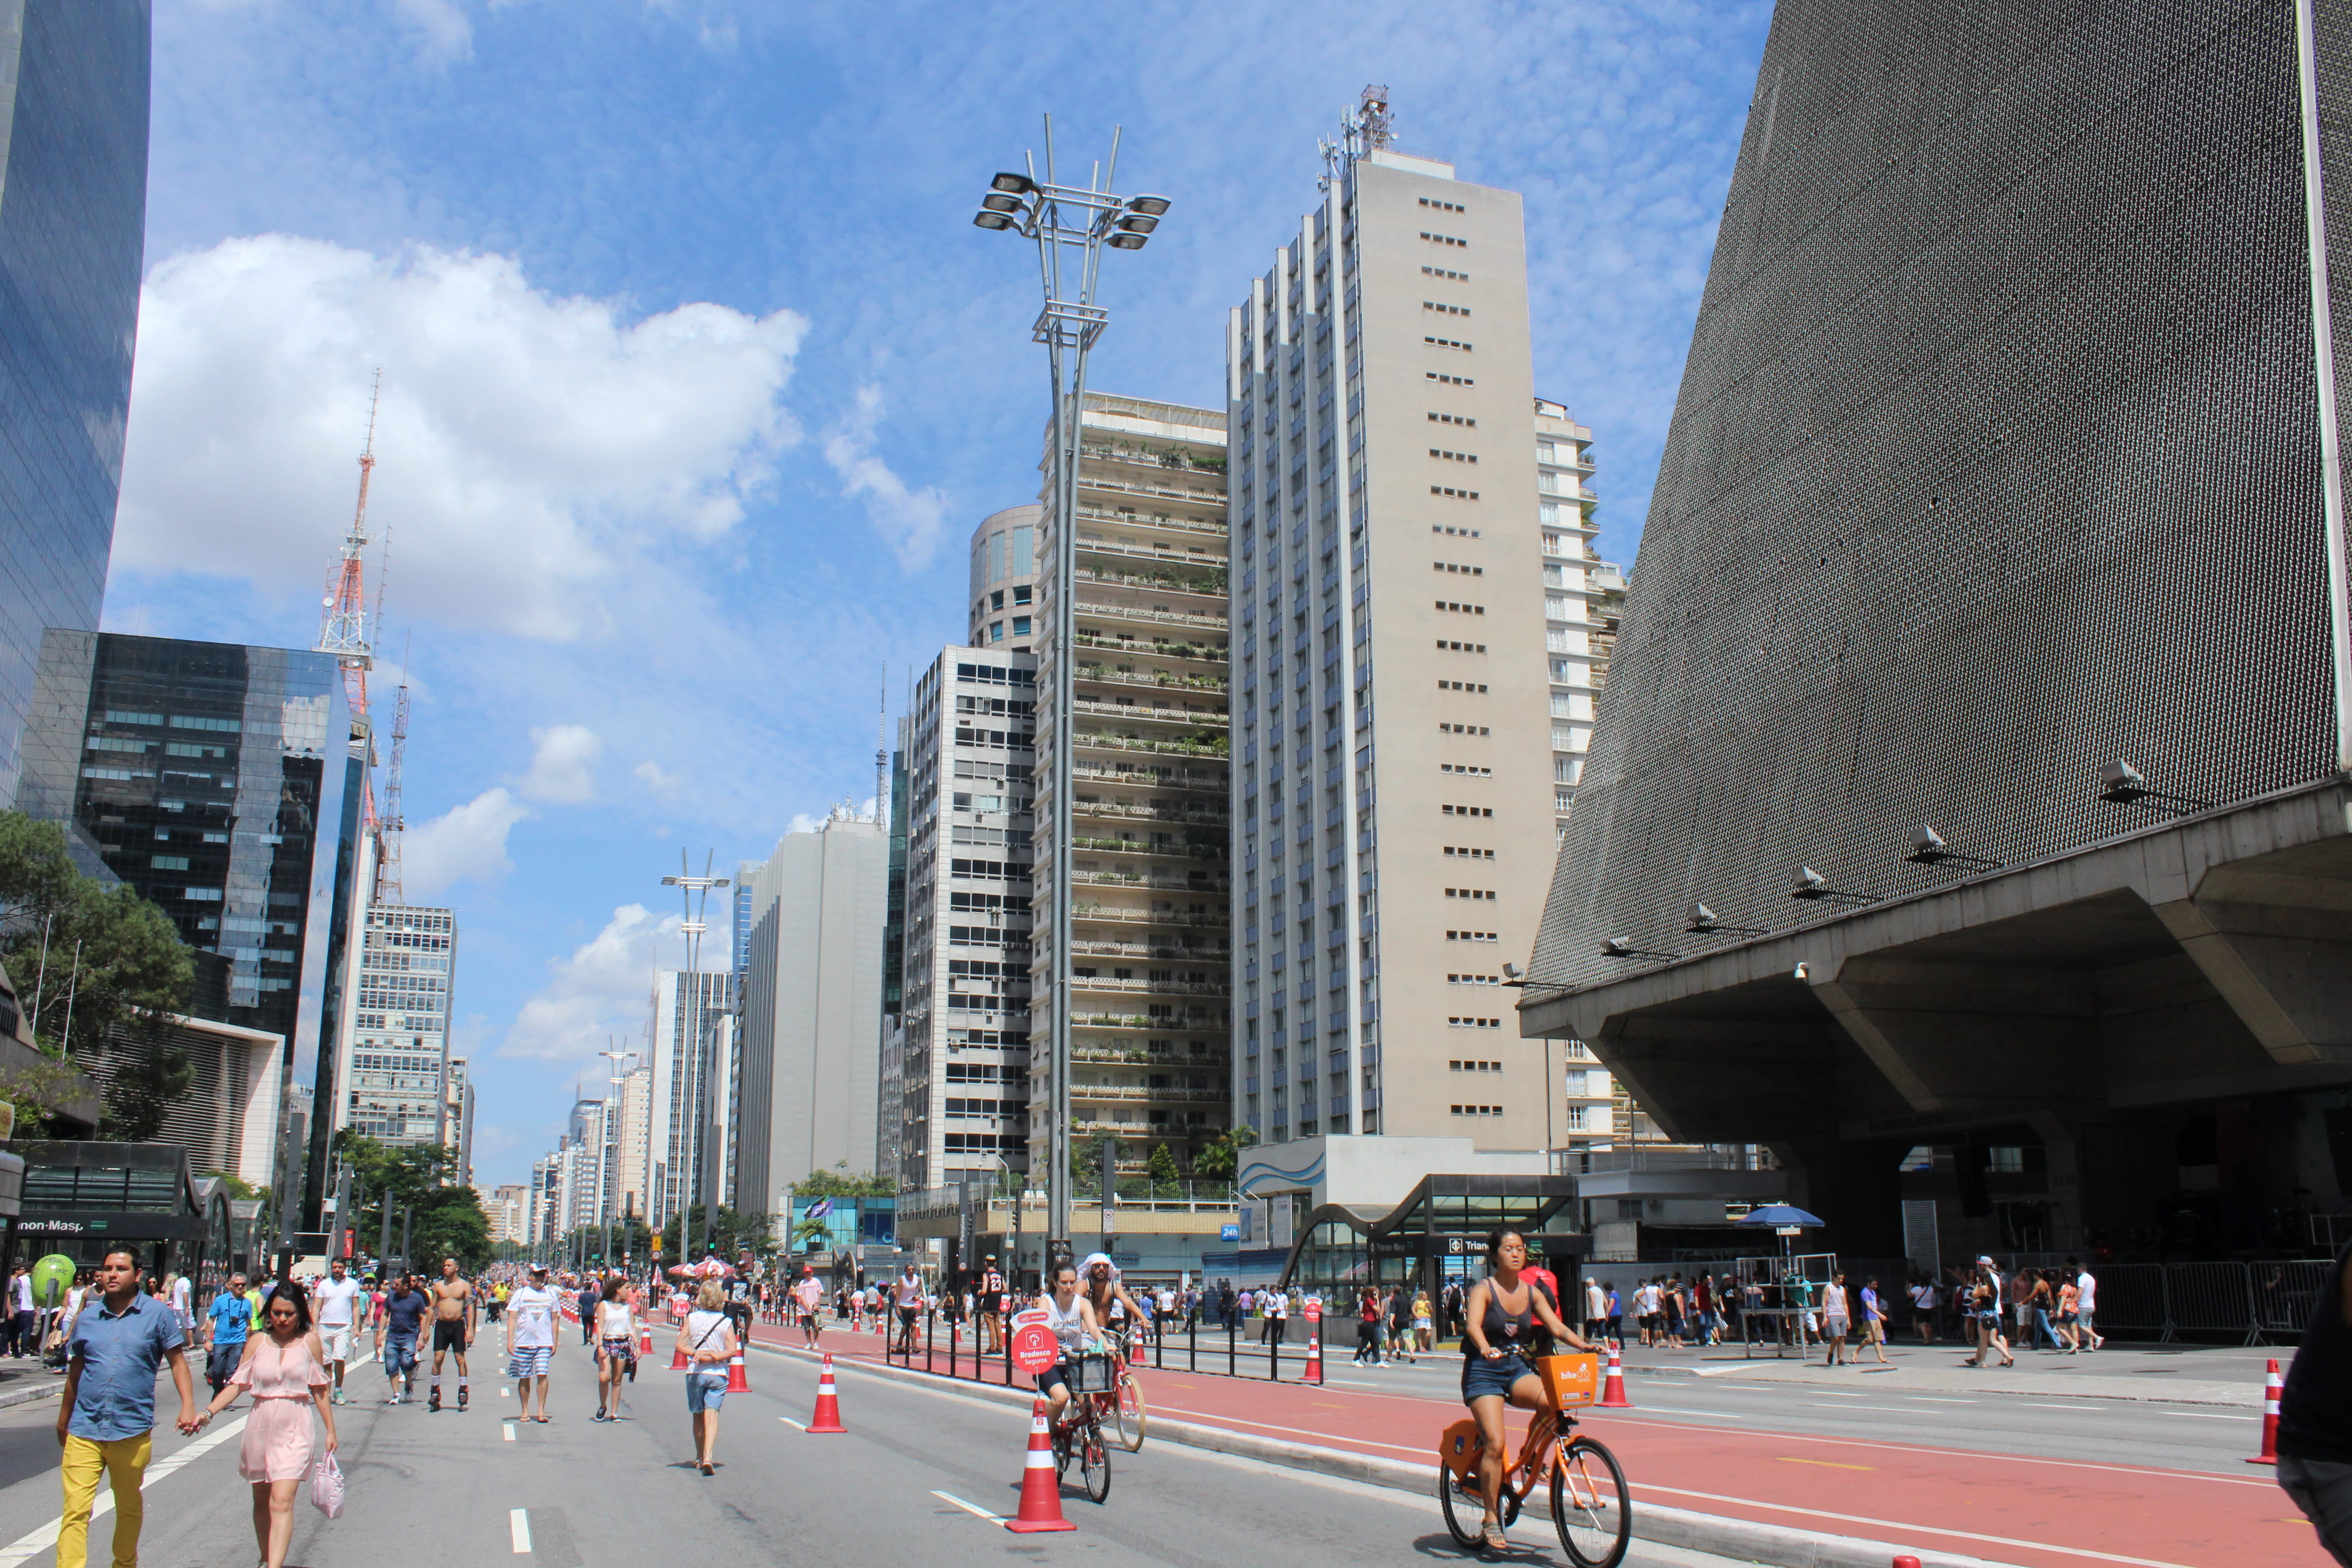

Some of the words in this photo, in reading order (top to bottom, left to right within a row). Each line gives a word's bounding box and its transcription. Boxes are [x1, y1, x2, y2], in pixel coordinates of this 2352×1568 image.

[18, 1220, 83, 1233] non-Masp
[1223, 1228, 1238, 1237] 24h
[991, 1279, 1001, 1292] 23
[1020, 1349, 1051, 1358] Bradesco
[1561, 1371, 1577, 1379] bike
